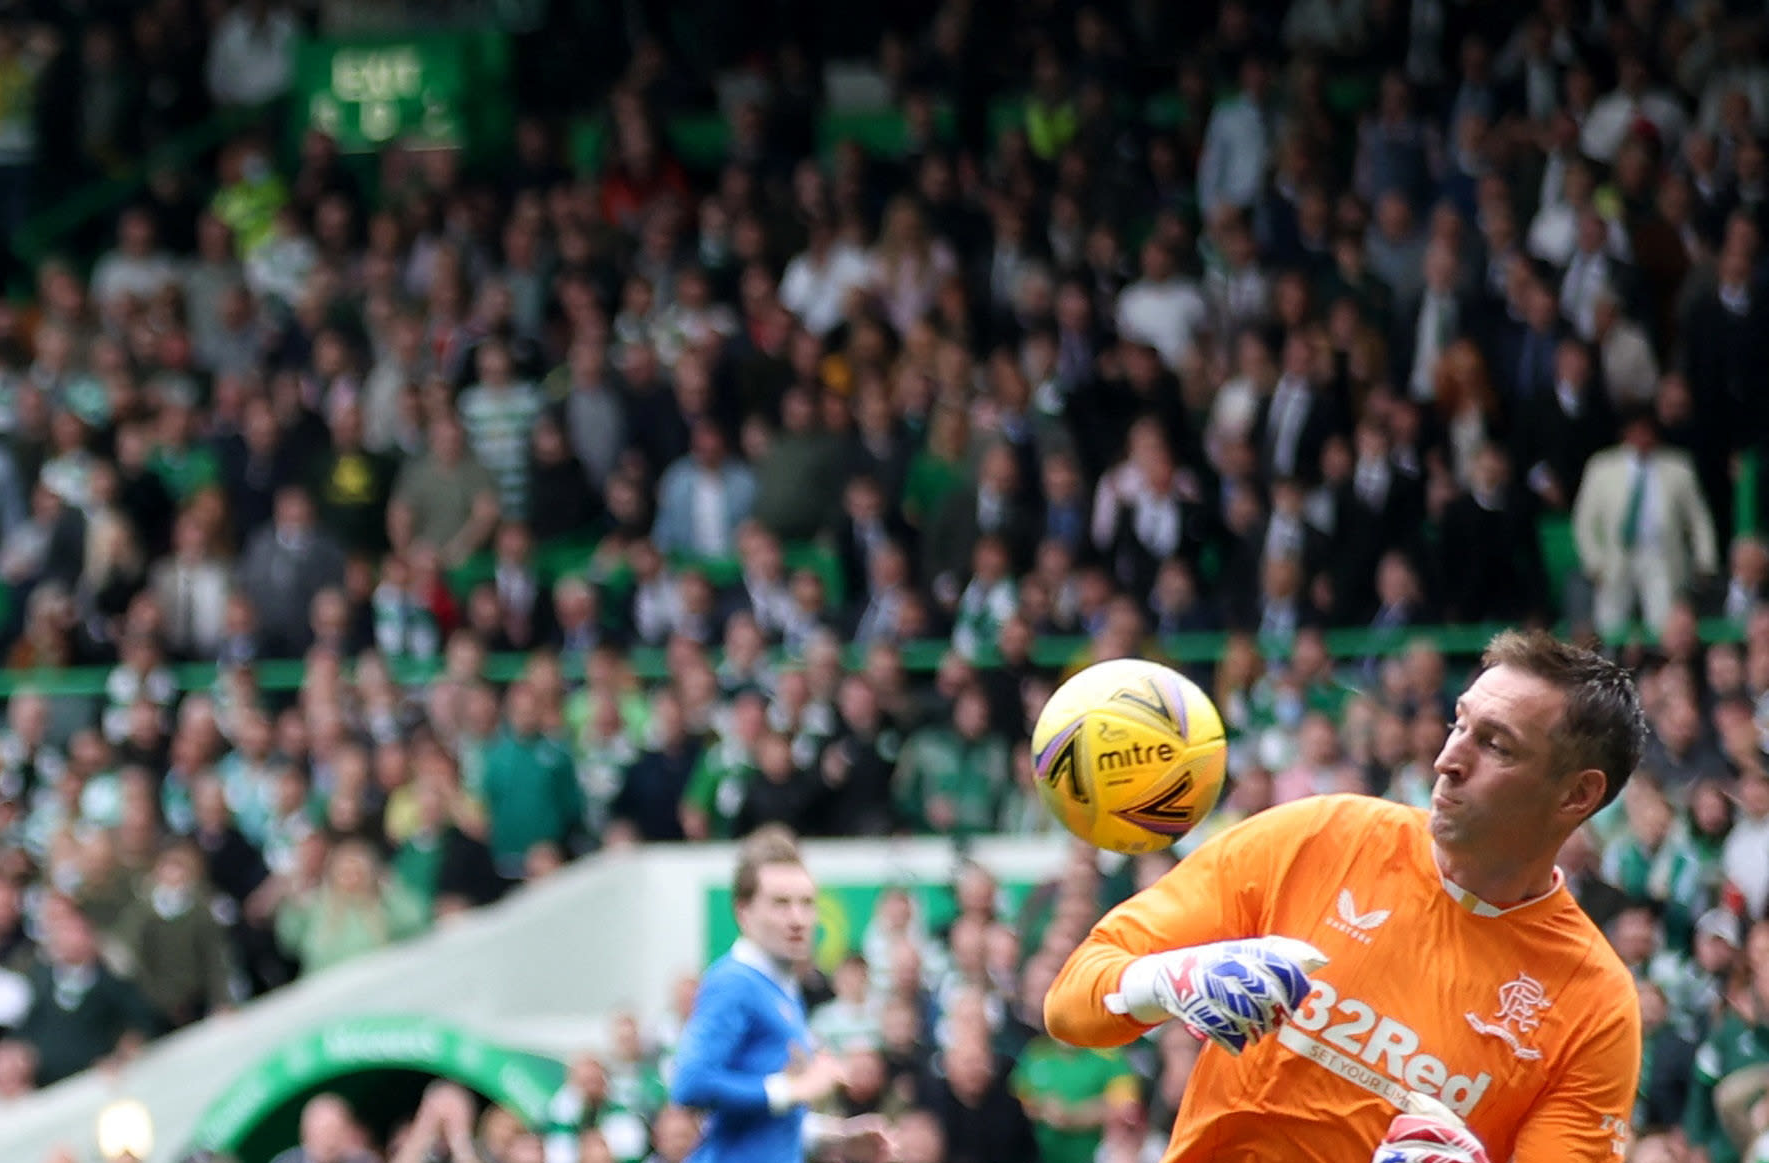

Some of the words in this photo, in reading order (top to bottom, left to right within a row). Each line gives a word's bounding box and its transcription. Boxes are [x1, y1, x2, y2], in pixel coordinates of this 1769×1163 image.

[1098, 742, 1174, 771] mitre
[1291, 979, 1492, 1117] 32Red
[1310, 1045, 1339, 1066] SET
[1340, 1061, 1383, 1090] YOUR
